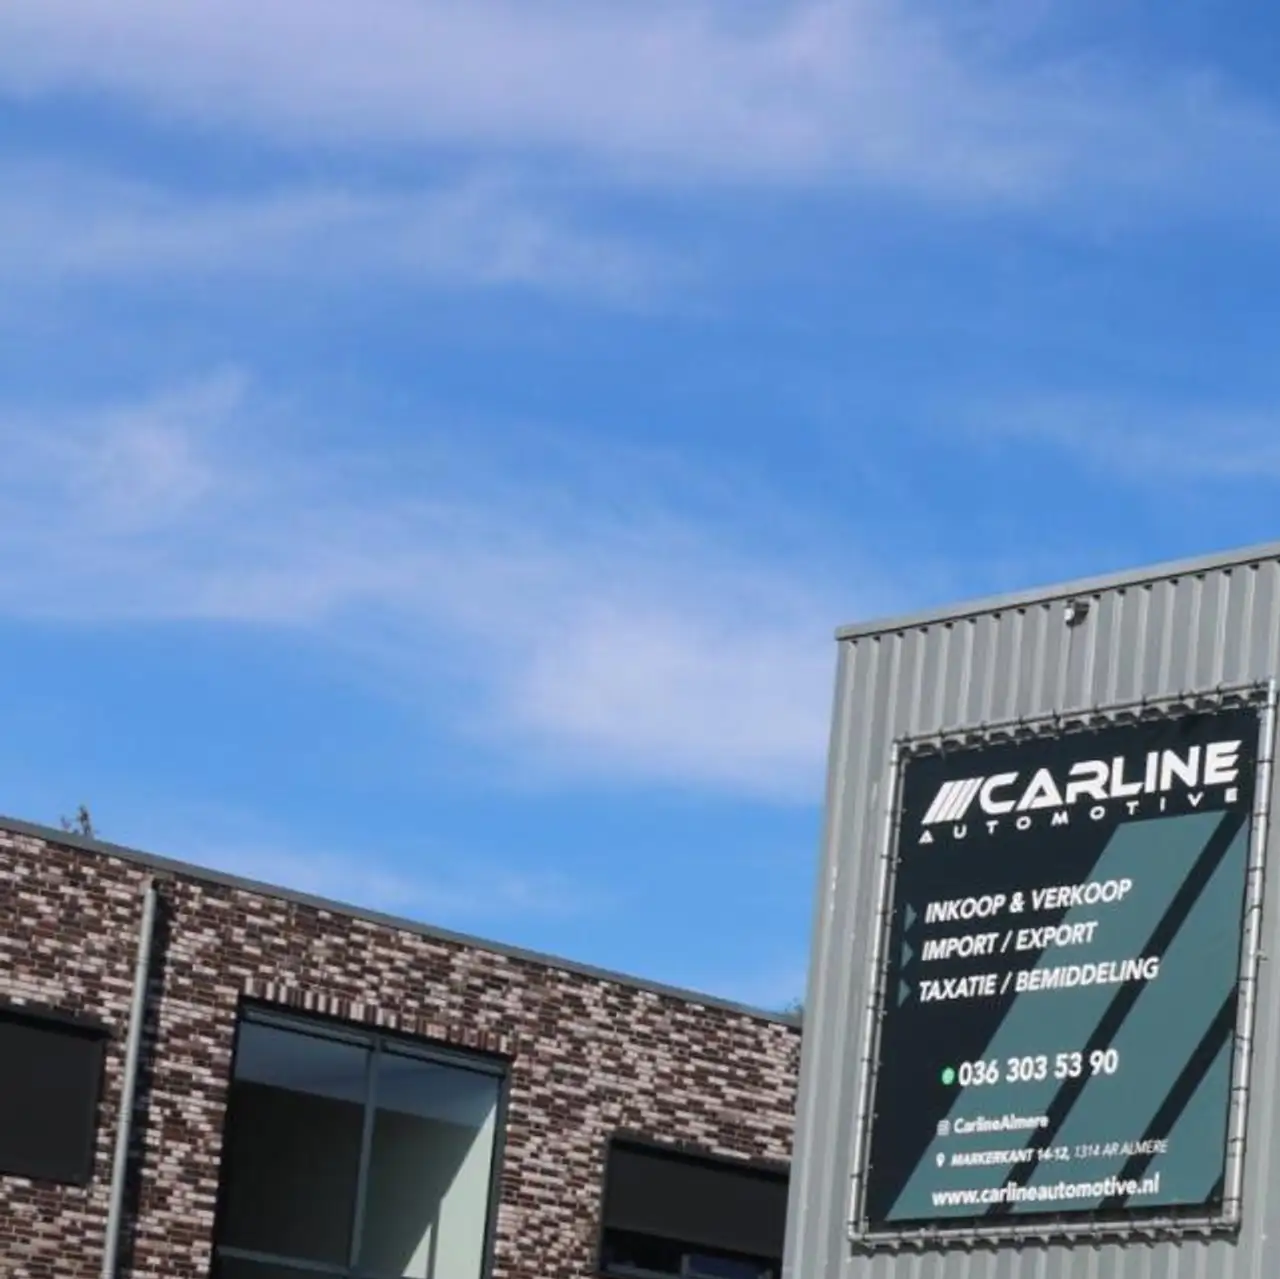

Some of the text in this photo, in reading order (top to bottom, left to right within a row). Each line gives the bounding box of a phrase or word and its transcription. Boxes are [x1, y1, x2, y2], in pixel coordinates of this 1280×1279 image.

[979, 740, 1242, 815] CARLINE
[918, 788, 1239, 844] AUTOMOTIVE
[925, 878, 1132, 924] INKOOP & VERKOOP
[922, 922, 1099, 962] IMPORT / EXPORT
[919, 957, 1160, 1003] TAXATIE / BEMIDDELING
[958, 1048, 1119, 1087] 036 303 53 90
[953, 1113, 1049, 1134] CarlineAlmere
[950, 1148, 1034, 1168] MARKERKANT
[931, 1171, 1161, 1206] www.carlineautomotive.nl
